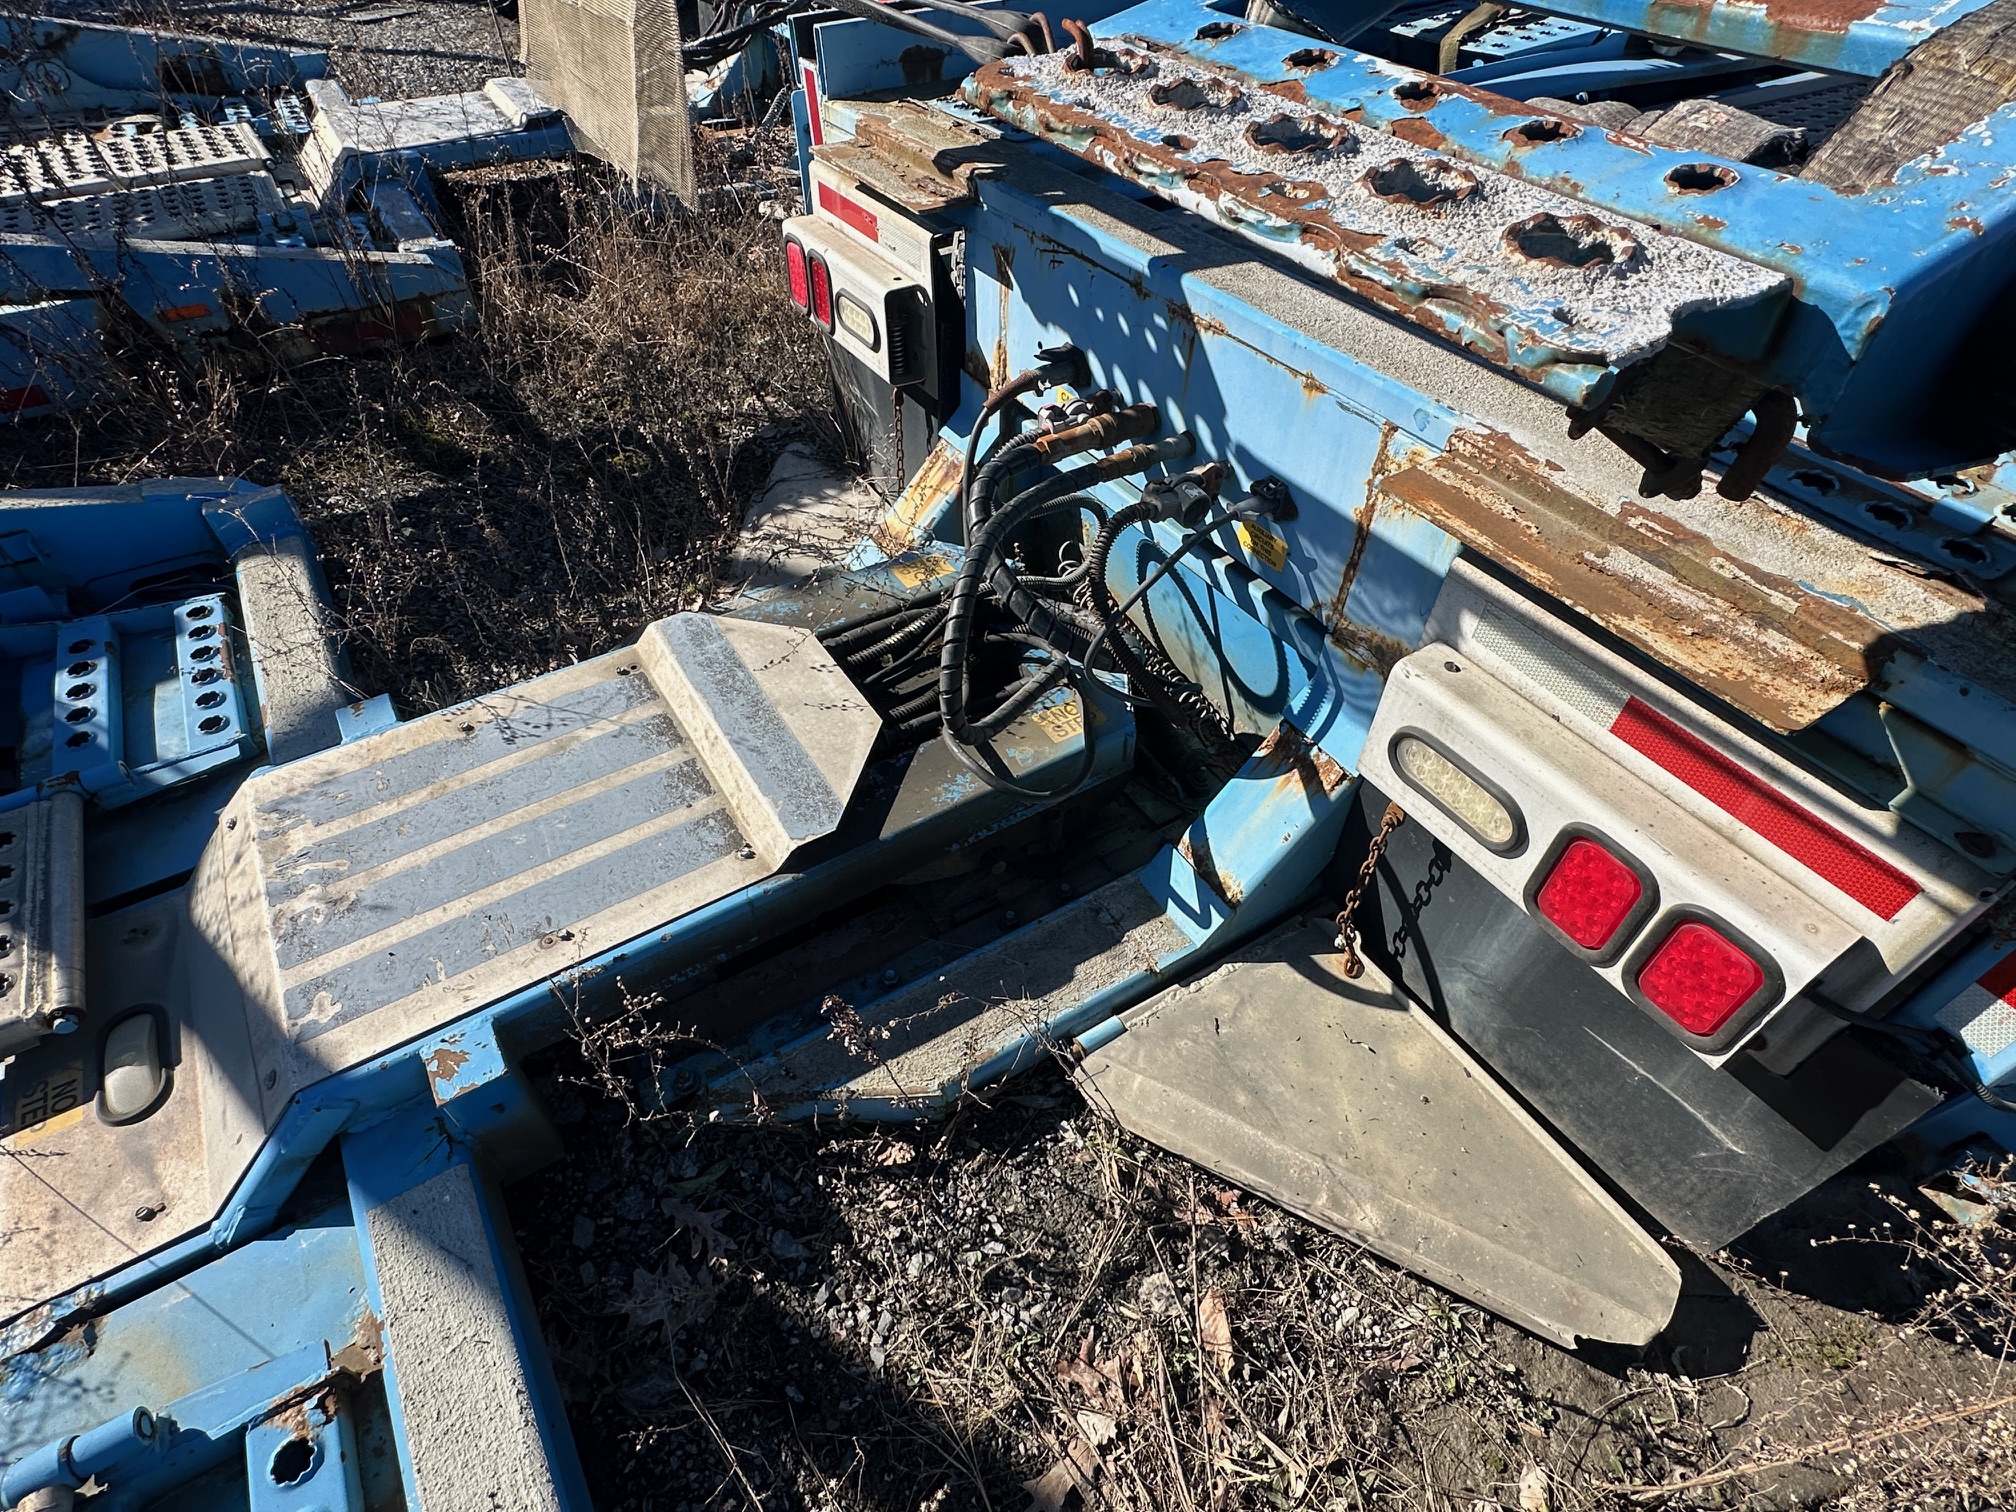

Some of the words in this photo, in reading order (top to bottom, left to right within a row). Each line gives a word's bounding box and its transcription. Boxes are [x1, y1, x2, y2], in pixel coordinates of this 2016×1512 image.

[1251, 523, 1277, 543] AUXILIARY
[1251, 530, 1275, 550] CIRCUITS
[1243, 540, 1277, 567] CONNECTION
[1260, 544, 1272, 557] THIS
[1050, 702, 1079, 721] NO
[51, 1078, 77, 1114] NO
[21, 1080, 48, 1134] STEP
